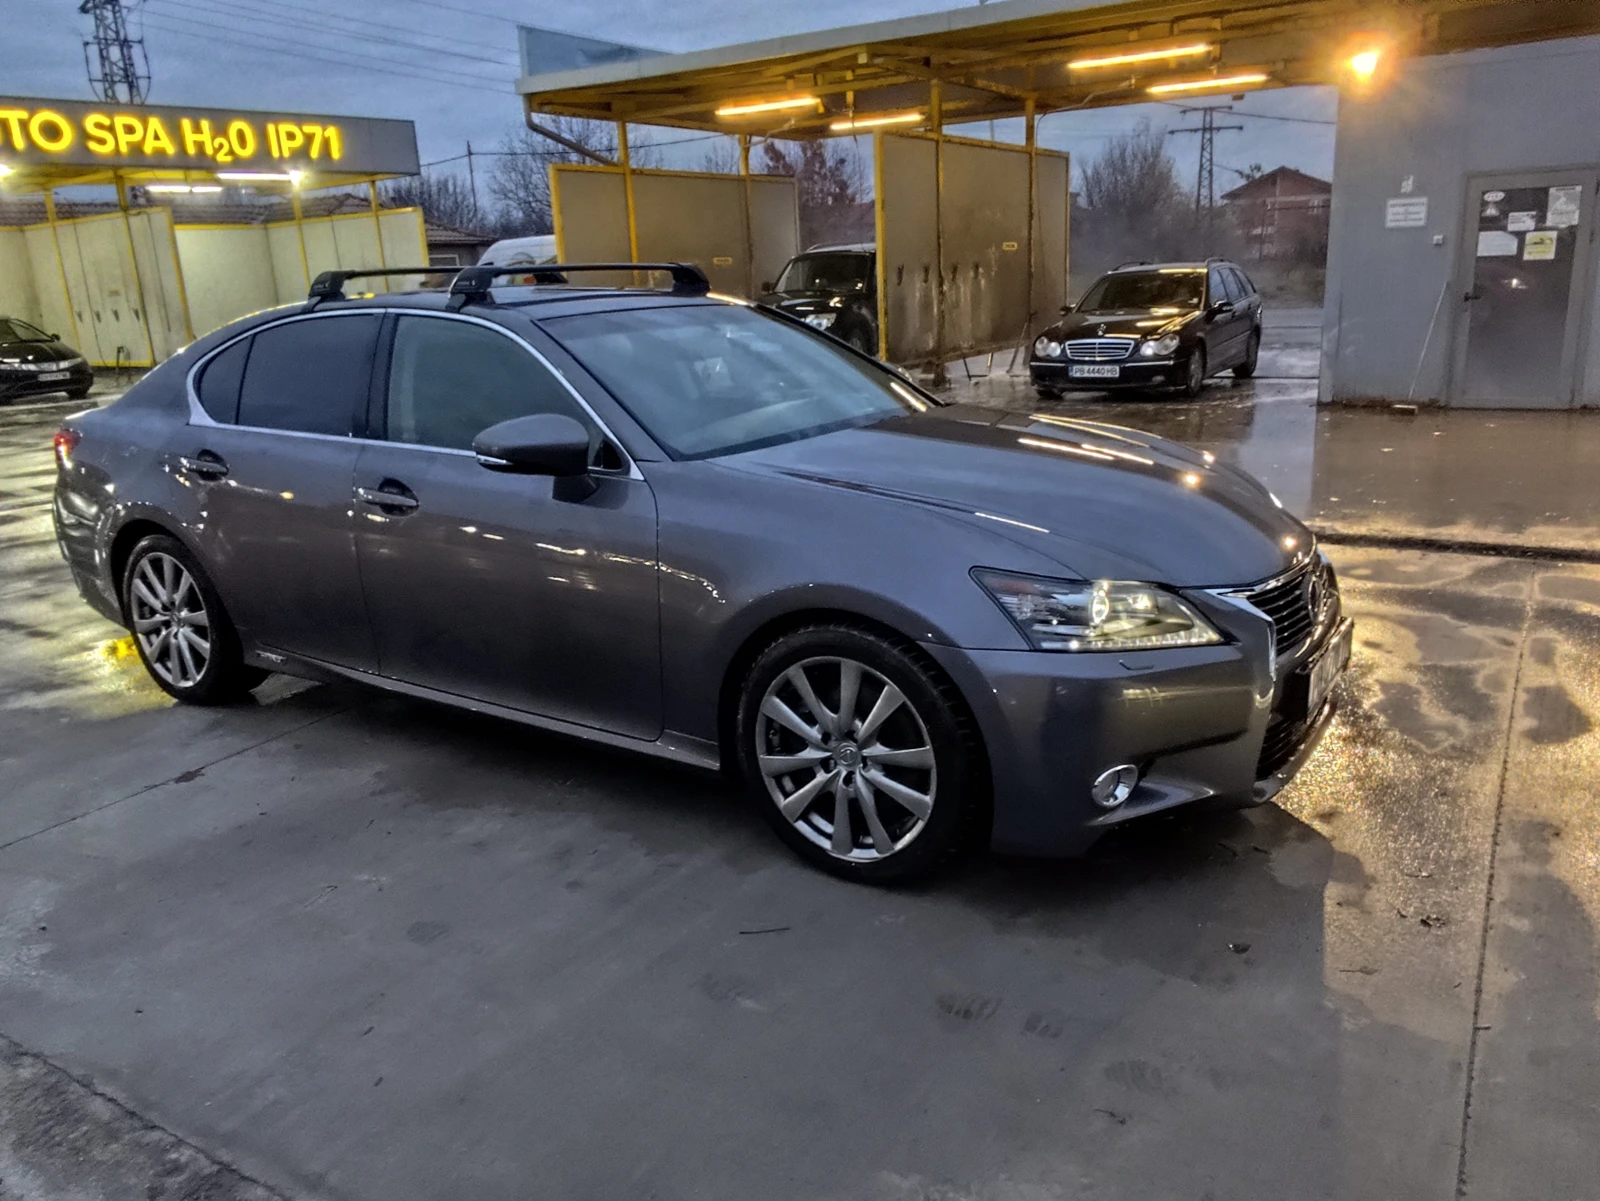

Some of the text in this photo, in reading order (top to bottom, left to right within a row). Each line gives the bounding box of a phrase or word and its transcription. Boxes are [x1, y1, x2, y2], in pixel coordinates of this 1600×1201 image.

[84, 113, 176, 155] SPA
[267, 123, 342, 160] IP71
[1074, 367, 1086, 376] PB
[1087, 367, 1106, 376] 4440
